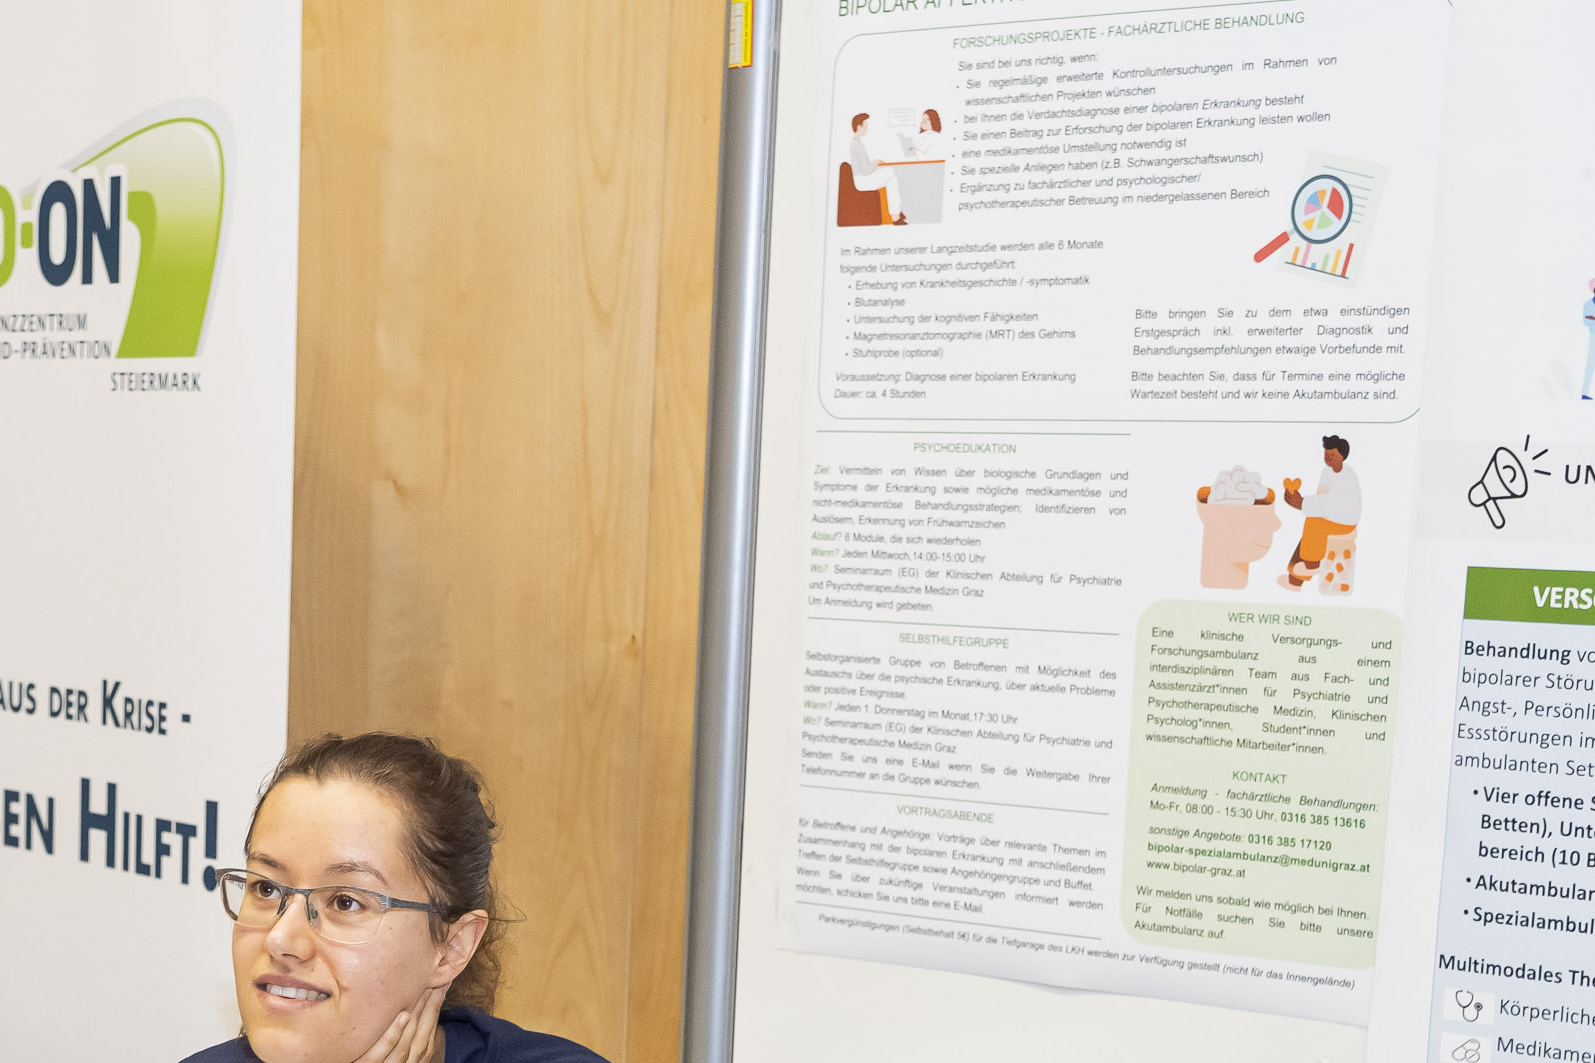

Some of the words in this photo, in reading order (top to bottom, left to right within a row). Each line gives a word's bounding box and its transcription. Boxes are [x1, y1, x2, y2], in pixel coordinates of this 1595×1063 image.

[953, 27, 1097, 49] FORSCHUNGSPROJEKTE
[1108, 18, 1210, 38] FACHÄRZTLICHE
[1215, 11, 1305, 30] BEHANDLUNG
[1135, 308, 1157, 320] Bitte
[1169, 309, 1206, 321] bringen
[1217, 307, 1234, 319] Sie
[1245, 309, 1257, 319] zu
[1269, 306, 1291, 317] dem
[1303, 307, 1328, 317] etwa
[1340, 305, 1410, 319] einstündigen
[1134, 326, 1200, 340] Erstgespräch
[1247, 326, 1303, 337] erweiterter
[1317, 324, 1373, 339] Diagnostik
[1388, 323, 1409, 335] und
[1133, 344, 1271, 358] Behandlungsempfehlungen
[1275, 344, 1316, 357] etwaige
[1320, 342, 1382, 355] Vorbefunde
[1386, 343, 1405, 354] mit.
[110, 372, 202, 392] STEIERMARK
[1132, 370, 1153, 382] Bitte
[1158, 371, 1204, 382] beachten
[1233, 371, 1257, 382] dass
[1262, 371, 1276, 382] für
[1280, 370, 1323, 382] Termine
[1328, 371, 1351, 382] eine
[1356, 370, 1405, 385] mögliche
[1130, 388, 1177, 399] Wartezeit
[1181, 389, 1218, 399] besteht
[1221, 388, 1240, 399] und
[1244, 389, 1258, 399] wir
[1262, 388, 1289, 399] keine
[1293, 388, 1369, 400] Akutambulanz
[1373, 388, 1398, 400] sind.
[913, 442, 1016, 454] PSYCHOEDUKATION
[1533, 585, 1595, 610] VERS
[1228, 611, 1254, 624] WER
[1258, 613, 1280, 625] WIR
[1284, 614, 1312, 626] SIND
[899, 632, 1009, 650] SELBSTHILFEGRUPPE
[1152, 626, 1174, 639] Eine
[1201, 629, 1244, 642] klinische
[1272, 633, 1342, 650] Versorgungs-
[1371, 640, 1392, 651] und
[1151, 644, 1259, 661] Forschungsambulanz
[1298, 655, 1317, 664] aus
[1357, 656, 1390, 668] einem
[1465, 640, 1571, 665] Behandlung
[1462, 666, 1540, 688] bipolarer
[1459, 695, 1516, 718] Angst-,
[1458, 723, 1572, 750] Essstörungen
[1455, 752, 1558, 775] ambulanten
[1233, 770, 1287, 785] KONTAKT
[1151, 782, 1207, 800] Anmeldung
[1227, 788, 1291, 805] fachärztliche
[1484, 786, 1519, 805] Vier
[1525, 790, 1584, 811] offene
[897, 804, 994, 825] VORTRAGSABENDE
[1186, 802, 1213, 816] 08:00
[1226, 806, 1252, 819] 15:30
[1281, 811, 1306, 824] 0316
[1310, 814, 1329, 826] 385
[1334, 816, 1365, 830] 13616
[1481, 813, 1552, 839] Betten),
[1149, 826, 1190, 840] sonstige
[1248, 833, 1273, 846] 0316
[1277, 836, 1296, 848] 385
[1300, 839, 1331, 852] 17120
[1148, 841, 1370, 873] bipolar-spezialambulanz@medunigraz.at
[1479, 841, 1544, 863] bereich
[1552, 847, 1580, 868] (10
[1146, 861, 1245, 878] www.bipolar-graz.at
[1137, 885, 1152, 896] Wir
[1156, 888, 1192, 901] melden
[1196, 894, 1213, 903] uns
[1217, 895, 1250, 908] sobald
[1254, 899, 1271, 910] wie
[1274, 901, 1314, 915] möglich
[1318, 904, 1333, 917] bei
[1134, 919, 1204, 938] Akutambulanz
[1135, 901, 1151, 913] Für
[1166, 905, 1203, 920] Notfälle
[1217, 913, 1254, 926] suchen
[1269, 916, 1285, 929] Sie
[1300, 920, 1322, 934] bitte
[1337, 927, 1373, 939] unsere
[1439, 953, 1562, 984] Multimodales
